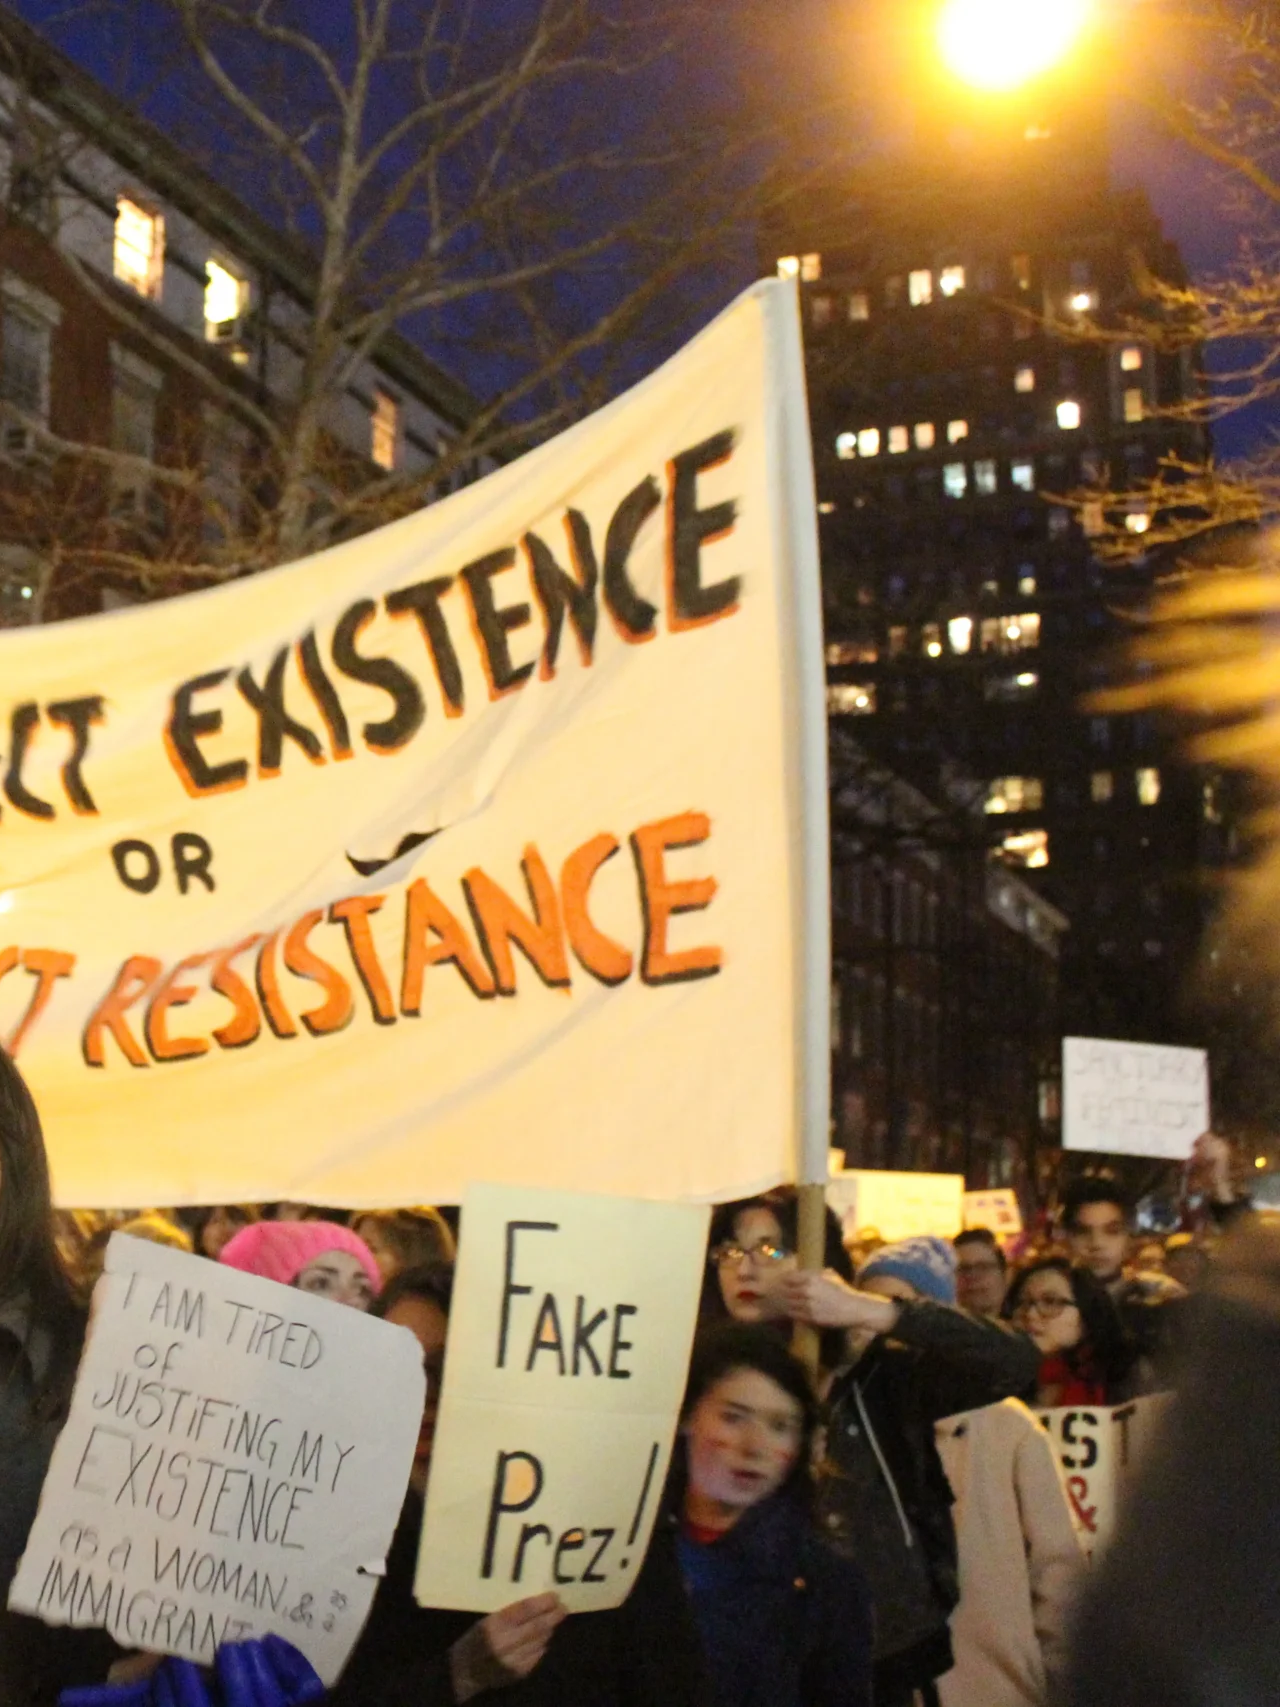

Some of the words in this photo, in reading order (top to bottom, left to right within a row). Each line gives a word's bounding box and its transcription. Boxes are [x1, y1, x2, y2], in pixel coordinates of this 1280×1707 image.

[165, 425, 742, 799] EXISTENCE
[111, 832, 215, 896] OR
[82, 809, 721, 1069] RESISTANCE
[122, 1271, 138, 1311] I
[149, 1281, 205, 1340] AM
[72, 1423, 313, 1551] EXISTENCE
[289, 1429, 356, 1493] MY
[479, 1440, 660, 1585] Prez!
